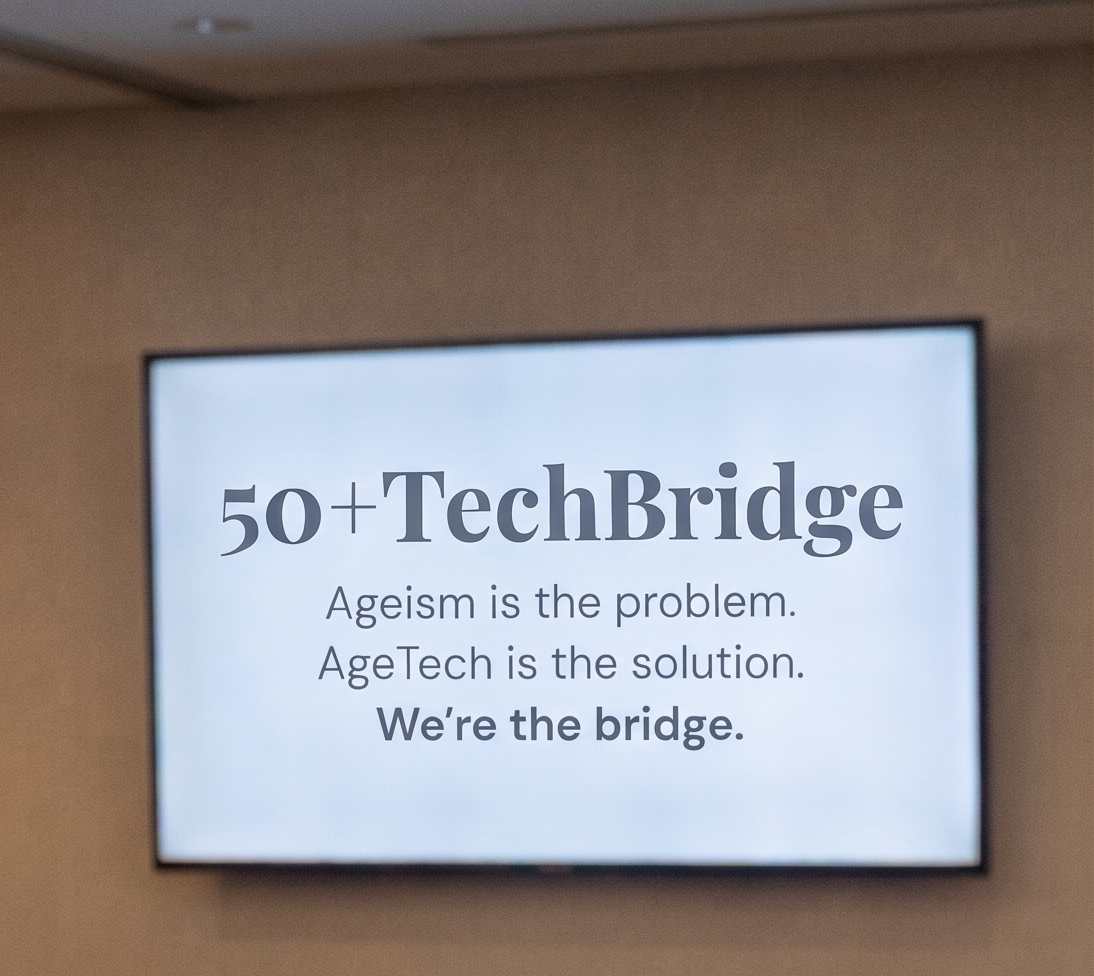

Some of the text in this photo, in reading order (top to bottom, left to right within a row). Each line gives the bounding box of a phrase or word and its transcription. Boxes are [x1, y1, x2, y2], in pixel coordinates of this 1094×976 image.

[221, 461, 904, 558] 50+TechBridge
[326, 583, 796, 630] Ageism is the problem.
[318, 644, 804, 690] AgeTech is the solution.
[376, 705, 744, 751] We’re the bridge.
